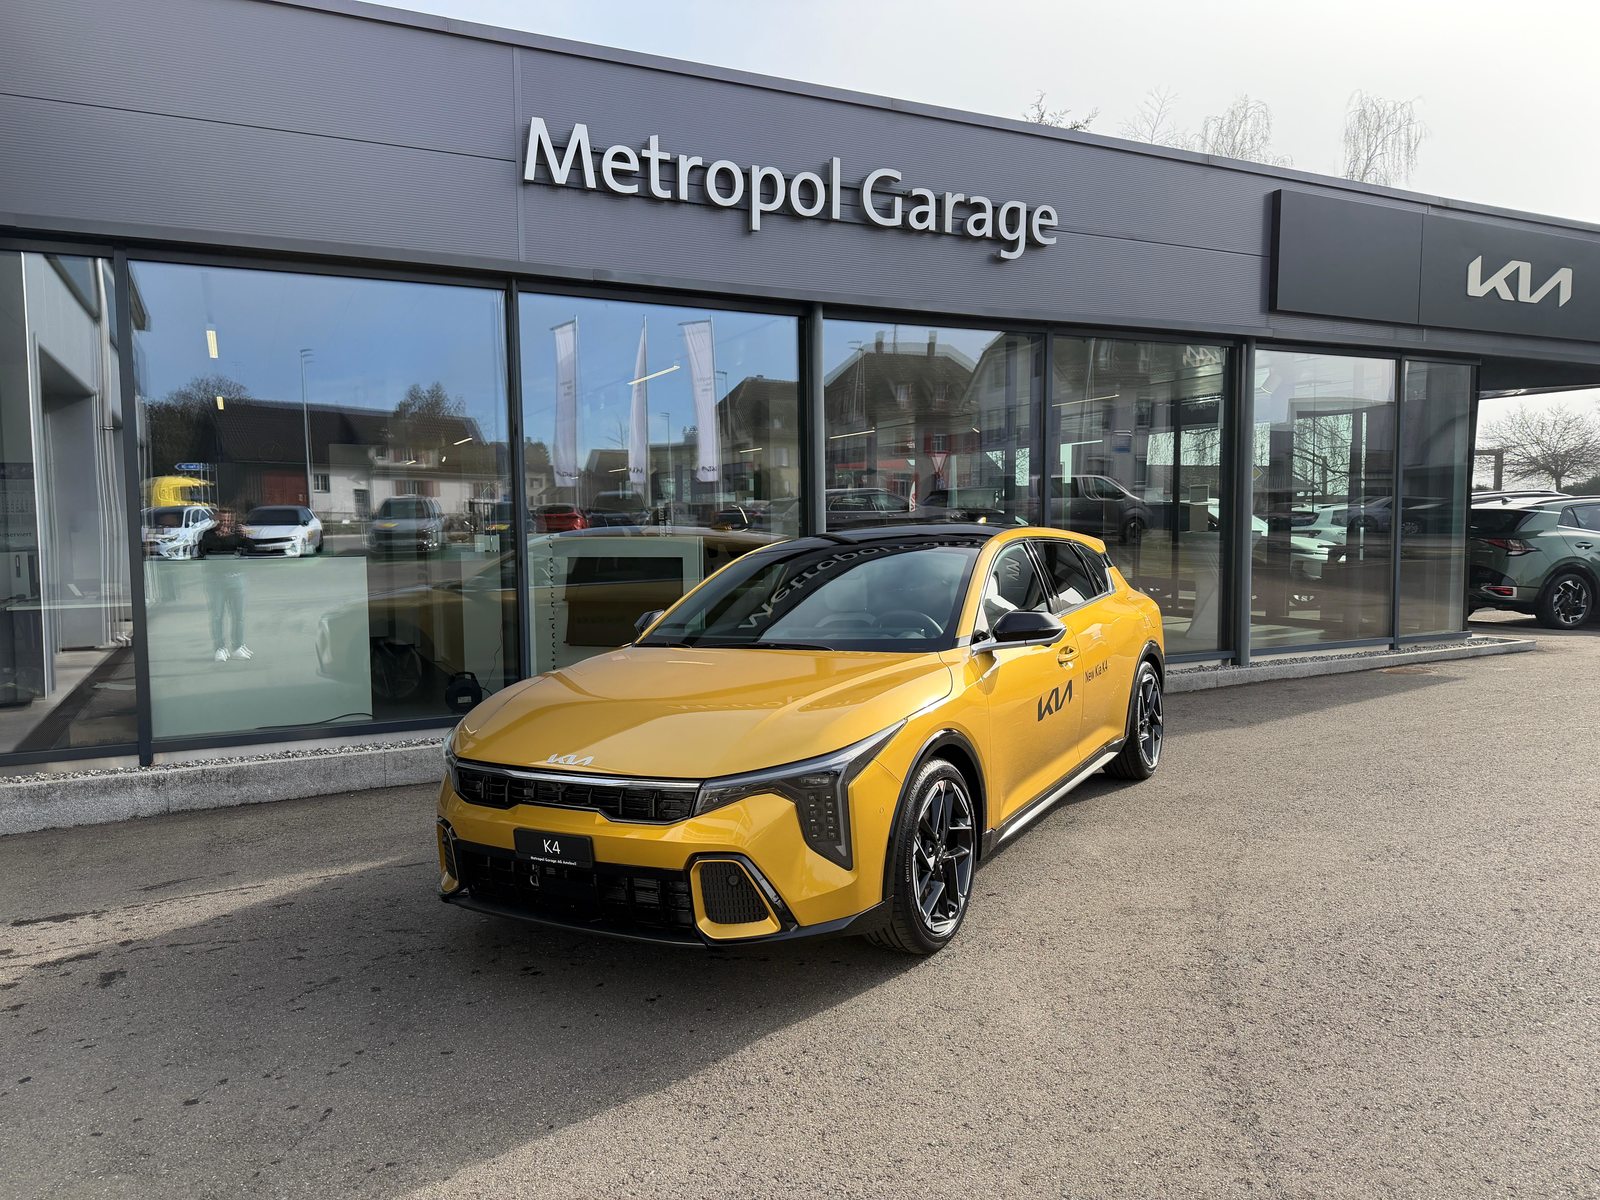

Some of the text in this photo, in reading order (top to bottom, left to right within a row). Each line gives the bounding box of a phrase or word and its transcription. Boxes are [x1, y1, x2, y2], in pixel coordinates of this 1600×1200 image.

[523, 116, 1060, 261] Metropol Garage
[1467, 255, 1573, 307] KIA
[1085, 669, 1095, 683] New
[1038, 679, 1072, 722] KIA
[546, 753, 593, 766] KIA
[543, 839, 561, 854] K4
